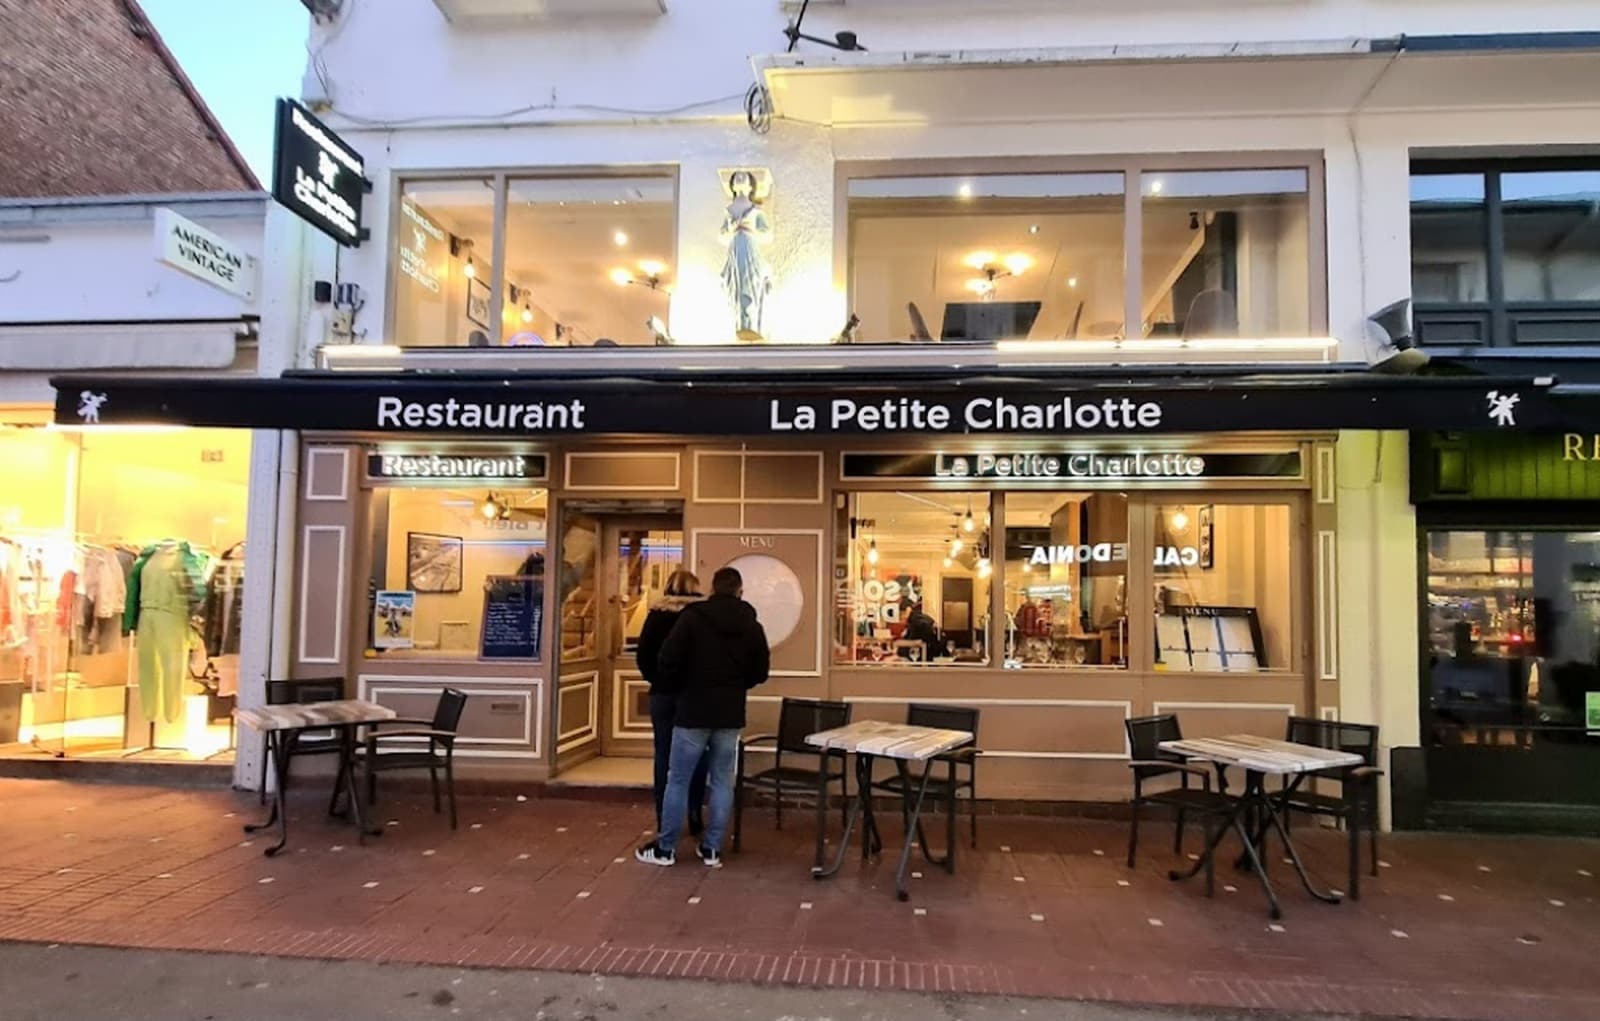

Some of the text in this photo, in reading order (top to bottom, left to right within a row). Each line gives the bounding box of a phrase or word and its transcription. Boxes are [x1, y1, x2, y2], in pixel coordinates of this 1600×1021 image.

[172, 225, 242, 269] AMERICAN
[178, 243, 234, 282] VINTAGE
[377, 397, 585, 429] Restaurant
[769, 396, 1163, 431] La Petite Charlotte
[380, 454, 526, 478] Restaurant
[934, 452, 1206, 477] La Petite Charlotte
[739, 535, 775, 549] MENU
[1184, 607, 1219, 616] MENU
